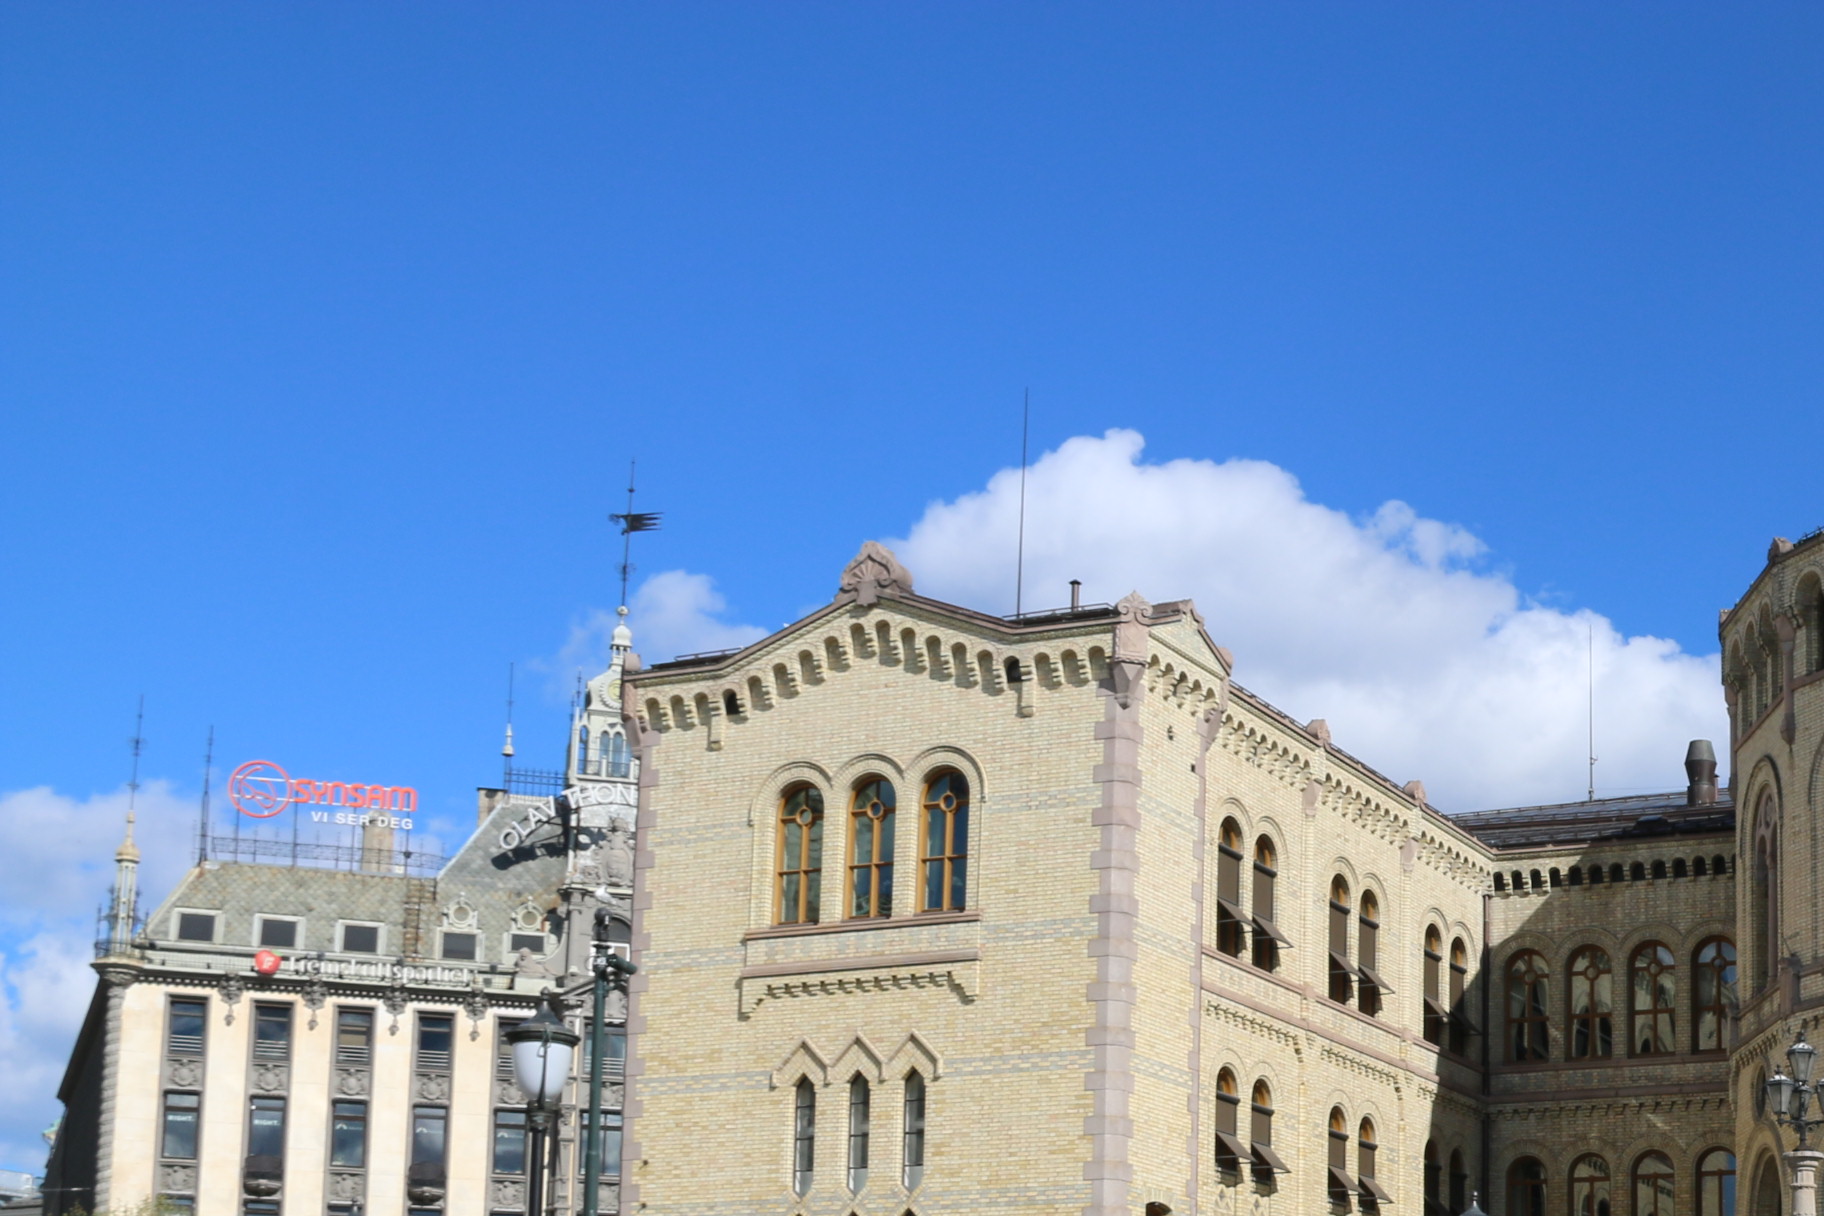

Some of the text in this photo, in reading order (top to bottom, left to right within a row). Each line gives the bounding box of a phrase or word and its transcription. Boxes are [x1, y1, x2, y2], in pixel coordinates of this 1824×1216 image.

[294, 778, 419, 812] SYNSAM
[311, 811, 414, 830] VI SER DEG
[500, 782, 634, 850] OLAV THON
